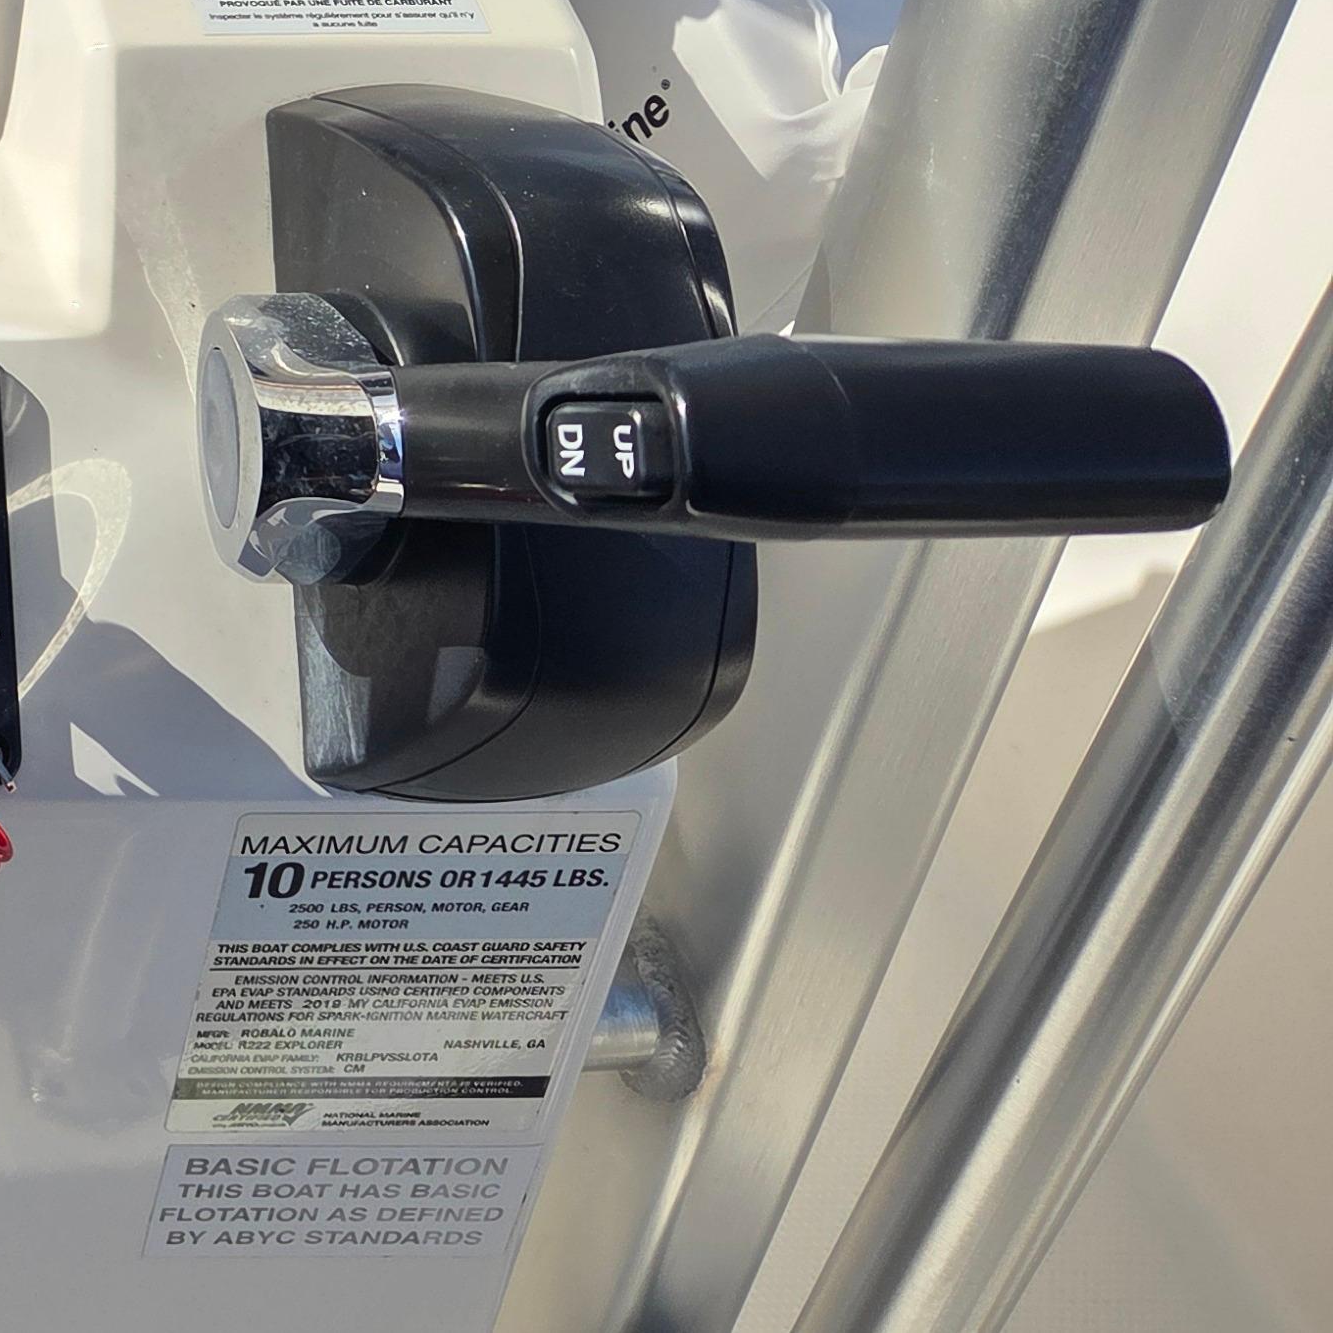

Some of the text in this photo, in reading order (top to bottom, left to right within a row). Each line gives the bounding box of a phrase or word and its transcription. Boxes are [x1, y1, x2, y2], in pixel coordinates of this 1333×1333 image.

[557, 423, 586, 478] DN
[612, 423, 635, 480] UP
[241, 833, 622, 855] MAXIMUM CAPACITIES
[244, 862, 610, 899] 10 PERSONS OR 1445 LBS.
[289, 902, 529, 915] 2500 LBS, PERSON, MOTOR, GEAR
[293, 919, 409, 930] 250 H.P. MOTOR
[217, 941, 587, 953] THIS BOAT COMPLIES WITH U.S. COAST GUARD SAFETY
[213, 954, 582, 965] STANDARDS IN EFFECT ON THE DATE OF CERTIFICATION
[241, 1028, 356, 1038] ROBALO MARINE
[238, 1040, 344, 1050] R222 EXPLORER
[443, 1039, 546, 1050] NASHVILLE, GA
[185, 1157, 509, 1176] BASIC FLOTATION
[178, 1183, 501, 1199] THIS BOAT HAS BASIC
[158, 1207, 504, 1222] FLOTATION AS DEFINED
[166, 1230, 482, 1245] BY ABYC STANDARDS
